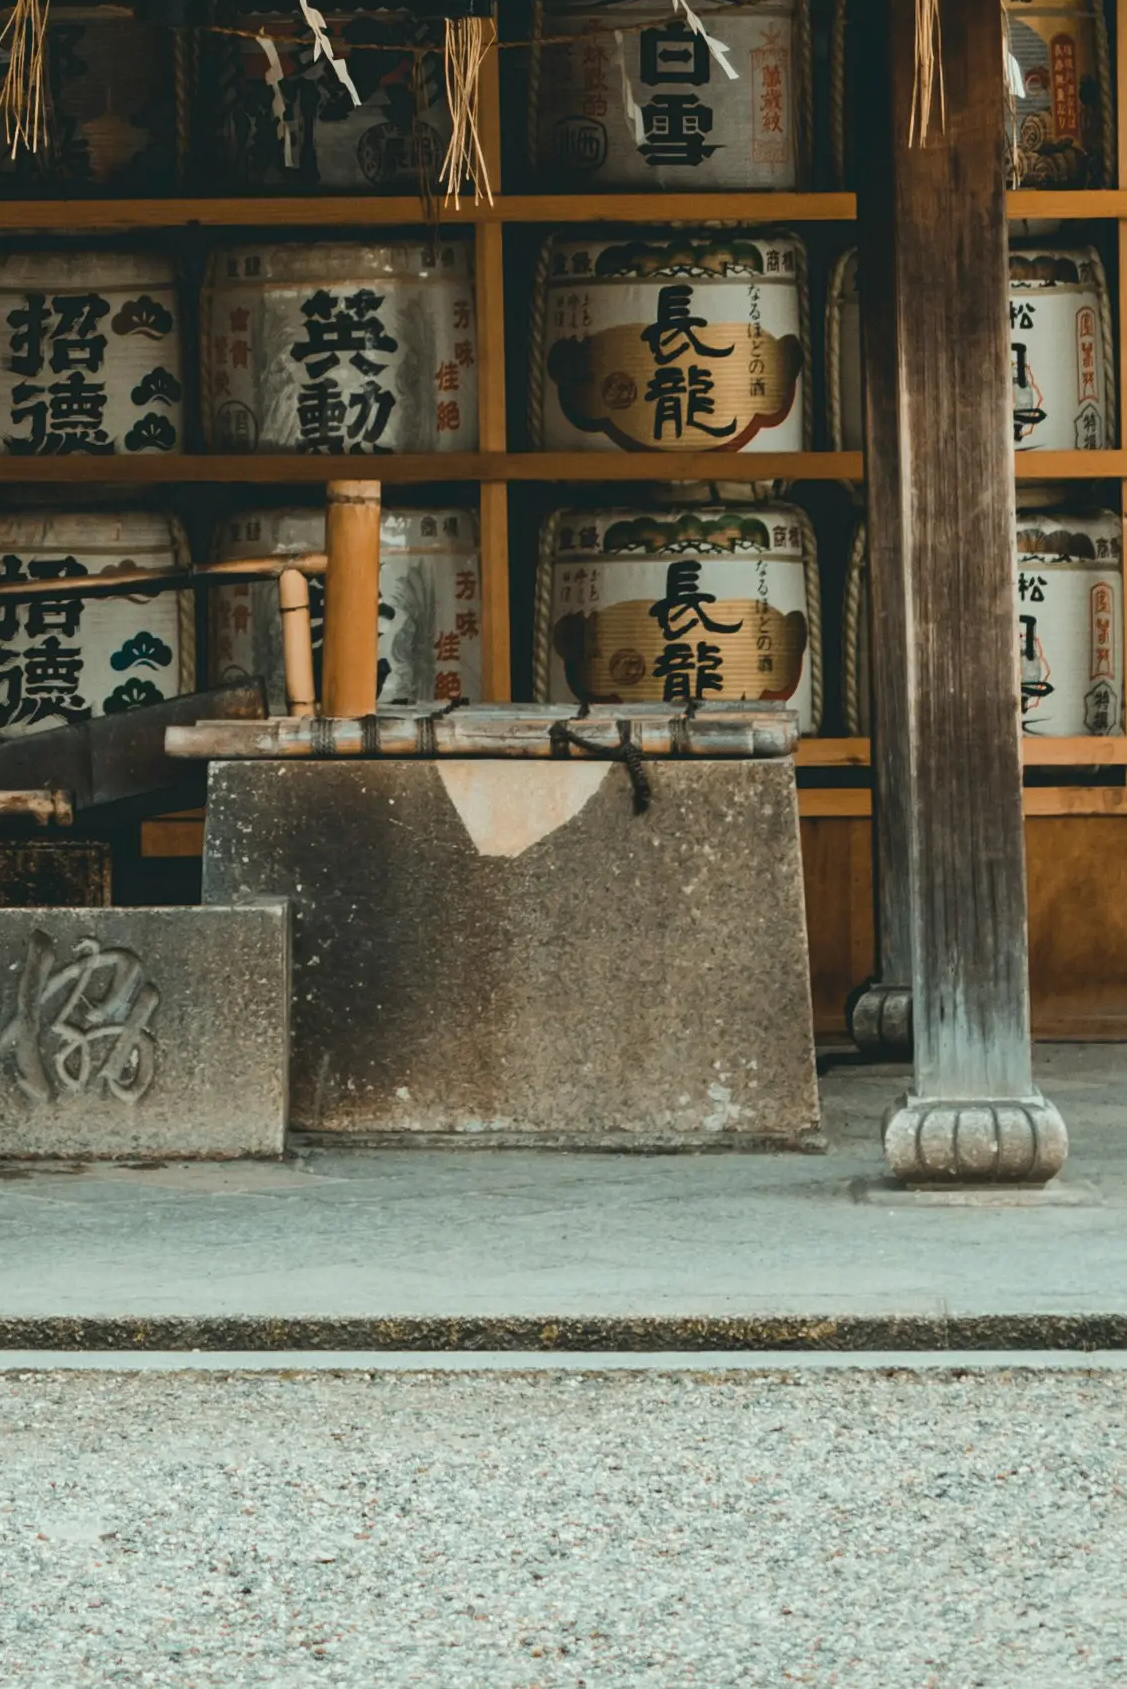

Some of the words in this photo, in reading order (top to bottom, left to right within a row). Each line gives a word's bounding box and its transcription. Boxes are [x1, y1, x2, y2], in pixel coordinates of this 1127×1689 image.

[635, 20, 728, 167] 白雪
[639, 284, 738, 441] 長龍
[747, 282, 766, 398] なるほどの酒
[753, 558, 775, 674] なるほどの酒
